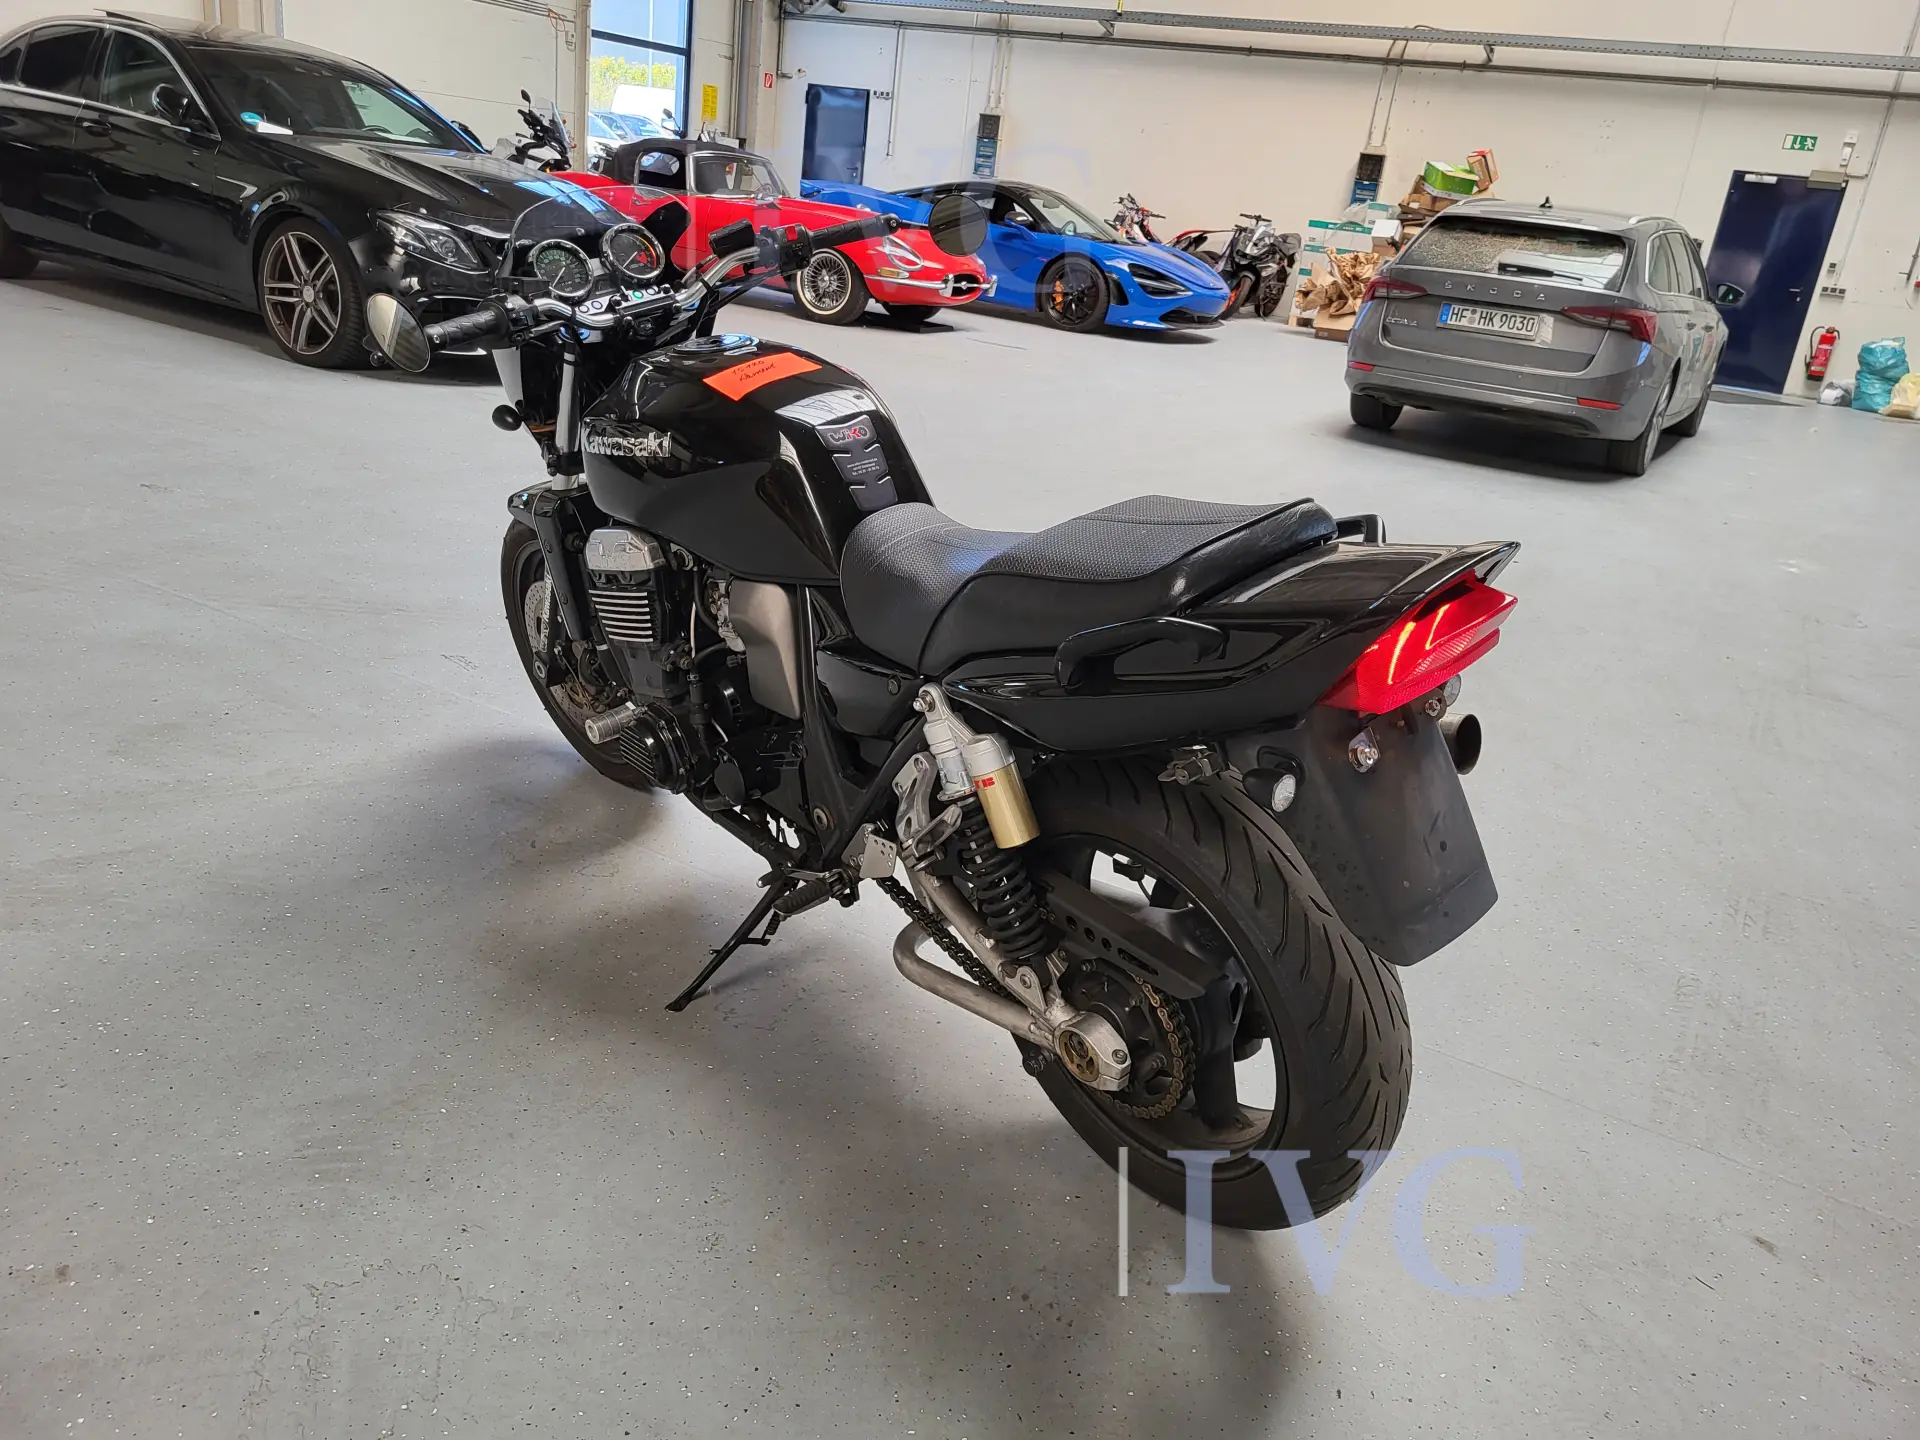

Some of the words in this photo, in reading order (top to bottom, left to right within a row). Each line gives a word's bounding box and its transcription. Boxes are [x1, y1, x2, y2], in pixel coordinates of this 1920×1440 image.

[1450, 307, 1470, 323] HF
[1477, 313, 1496, 328] HK
[1500, 315, 1536, 333] 9030
[581, 427, 672, 457] Kawasaki
